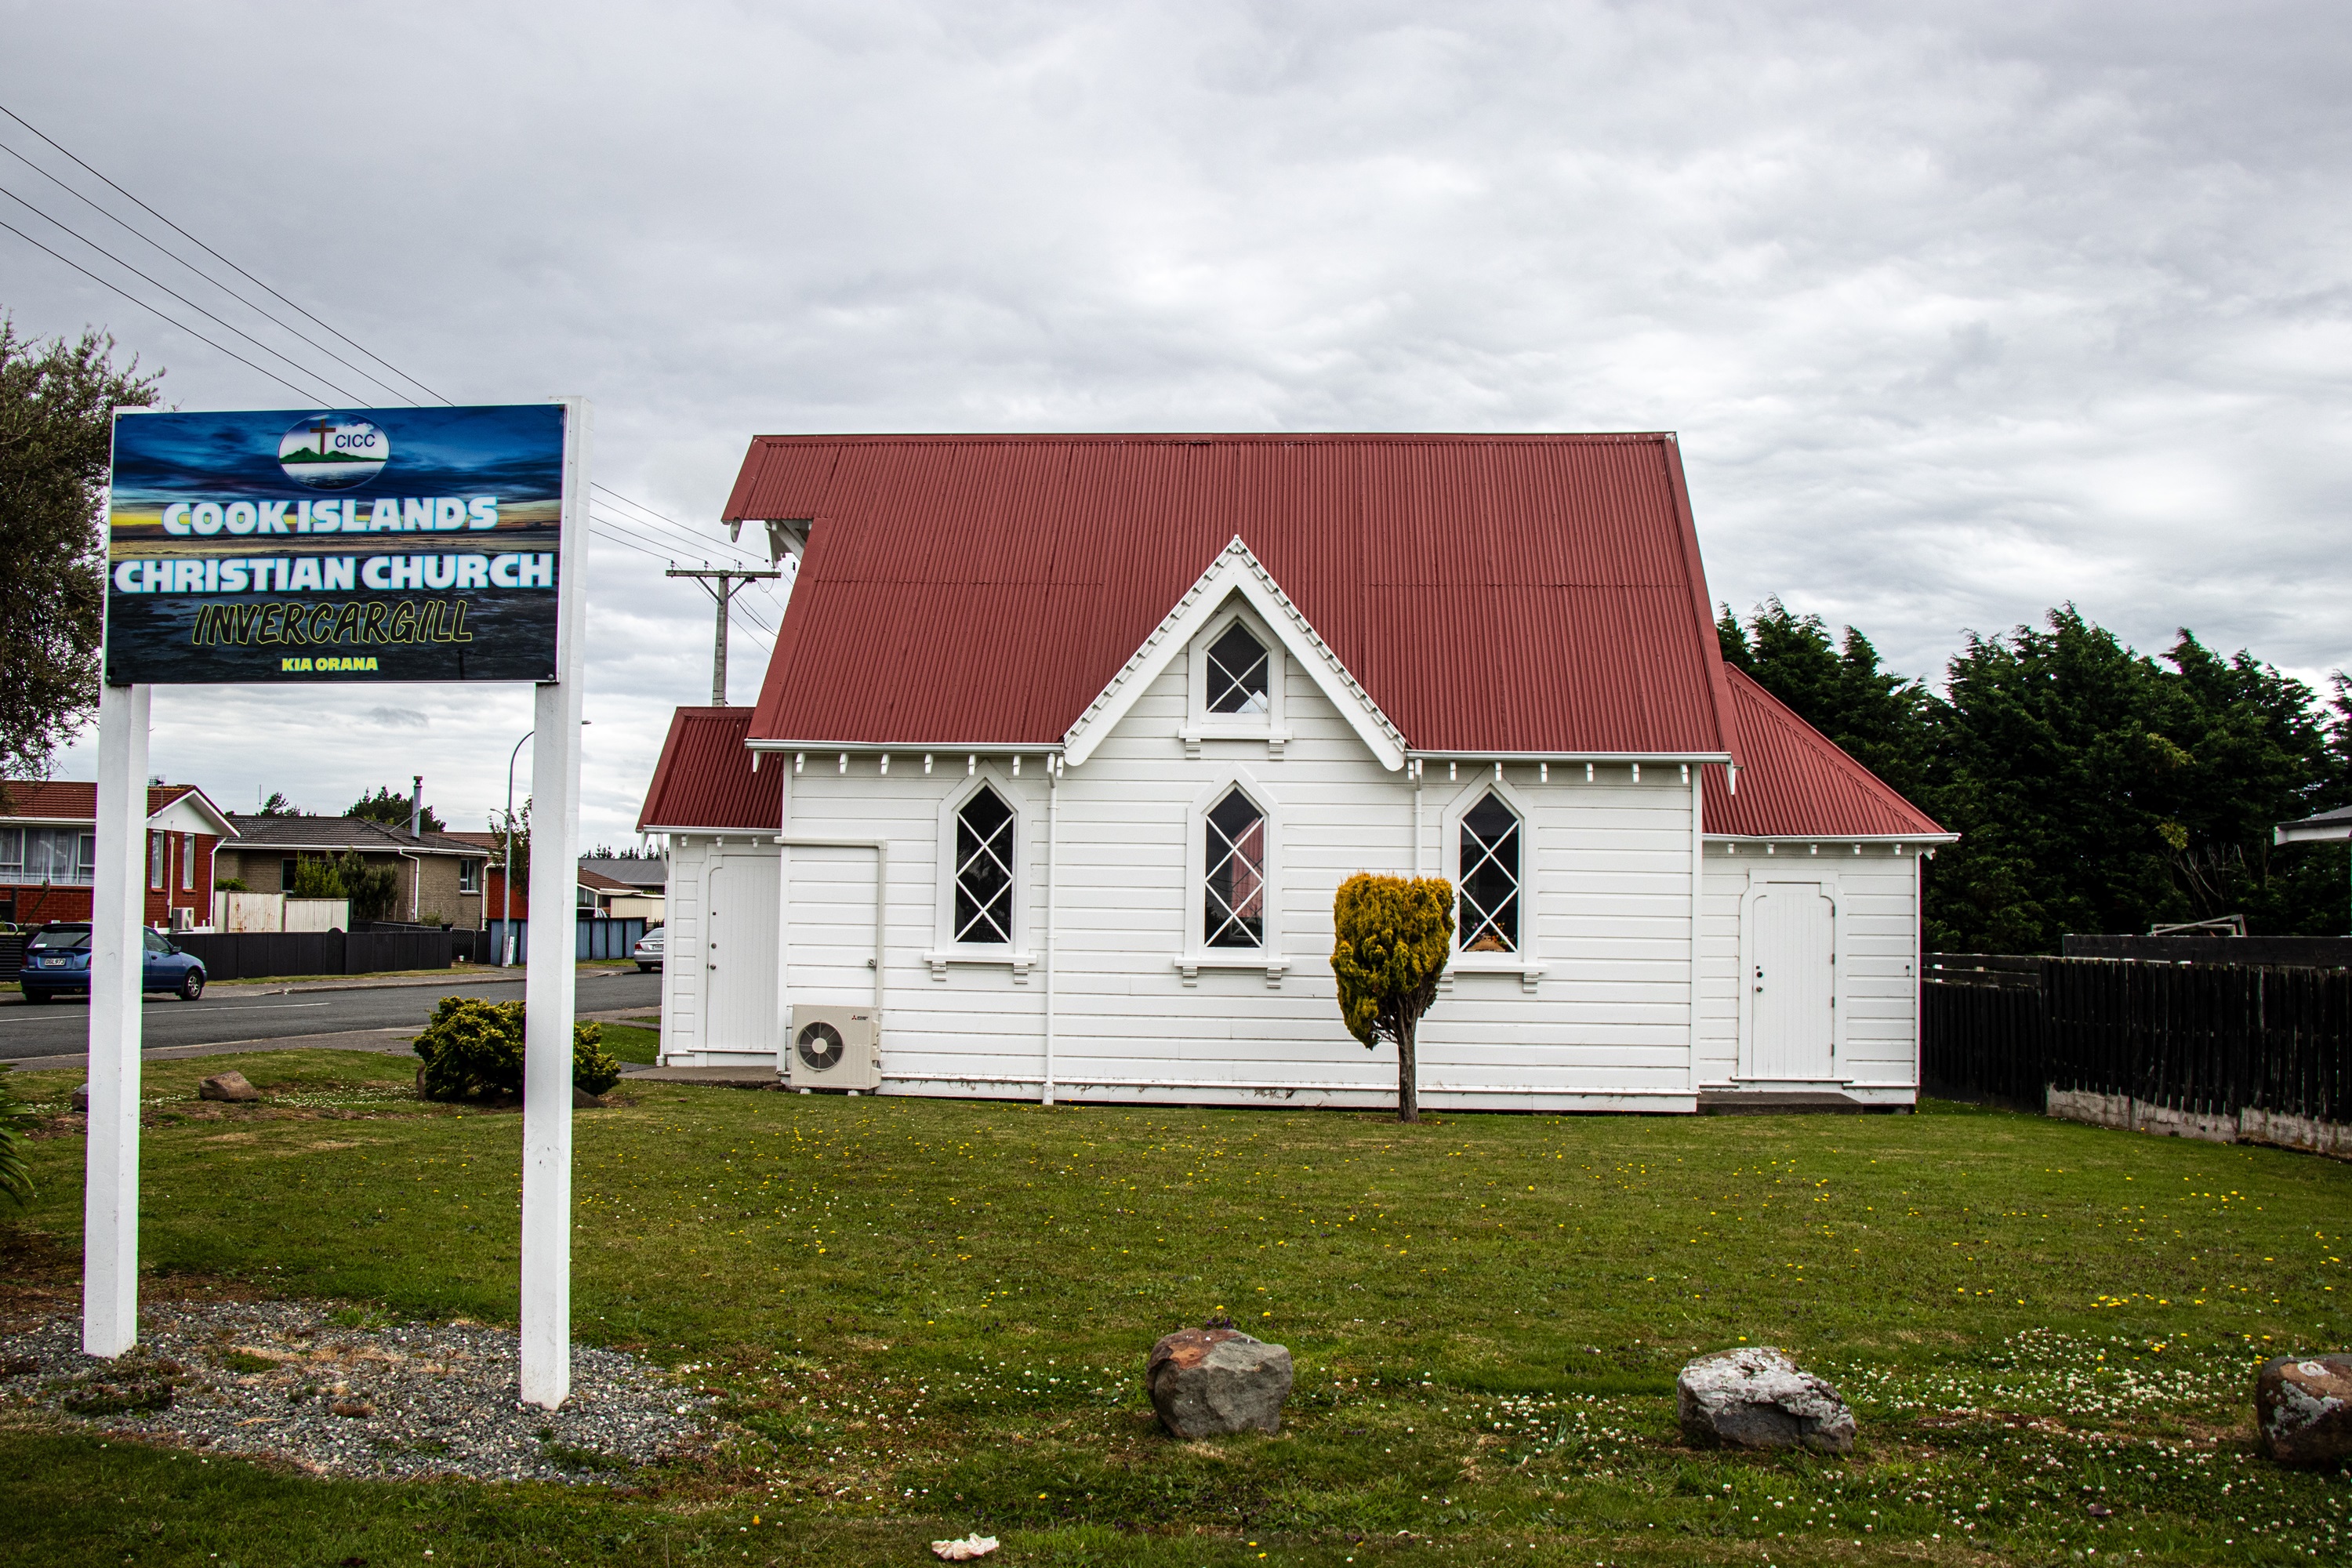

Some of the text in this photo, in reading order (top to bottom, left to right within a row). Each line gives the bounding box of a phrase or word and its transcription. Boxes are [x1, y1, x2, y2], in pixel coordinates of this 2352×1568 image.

[335, 434, 375, 448] CICC
[162, 496, 499, 535] COOK ISLANDS
[114, 554, 554, 593] CHRISTIAN CHURCH
[192, 601, 473, 645] INVERCARGILL
[282, 657, 378, 671] KIA ORANA
